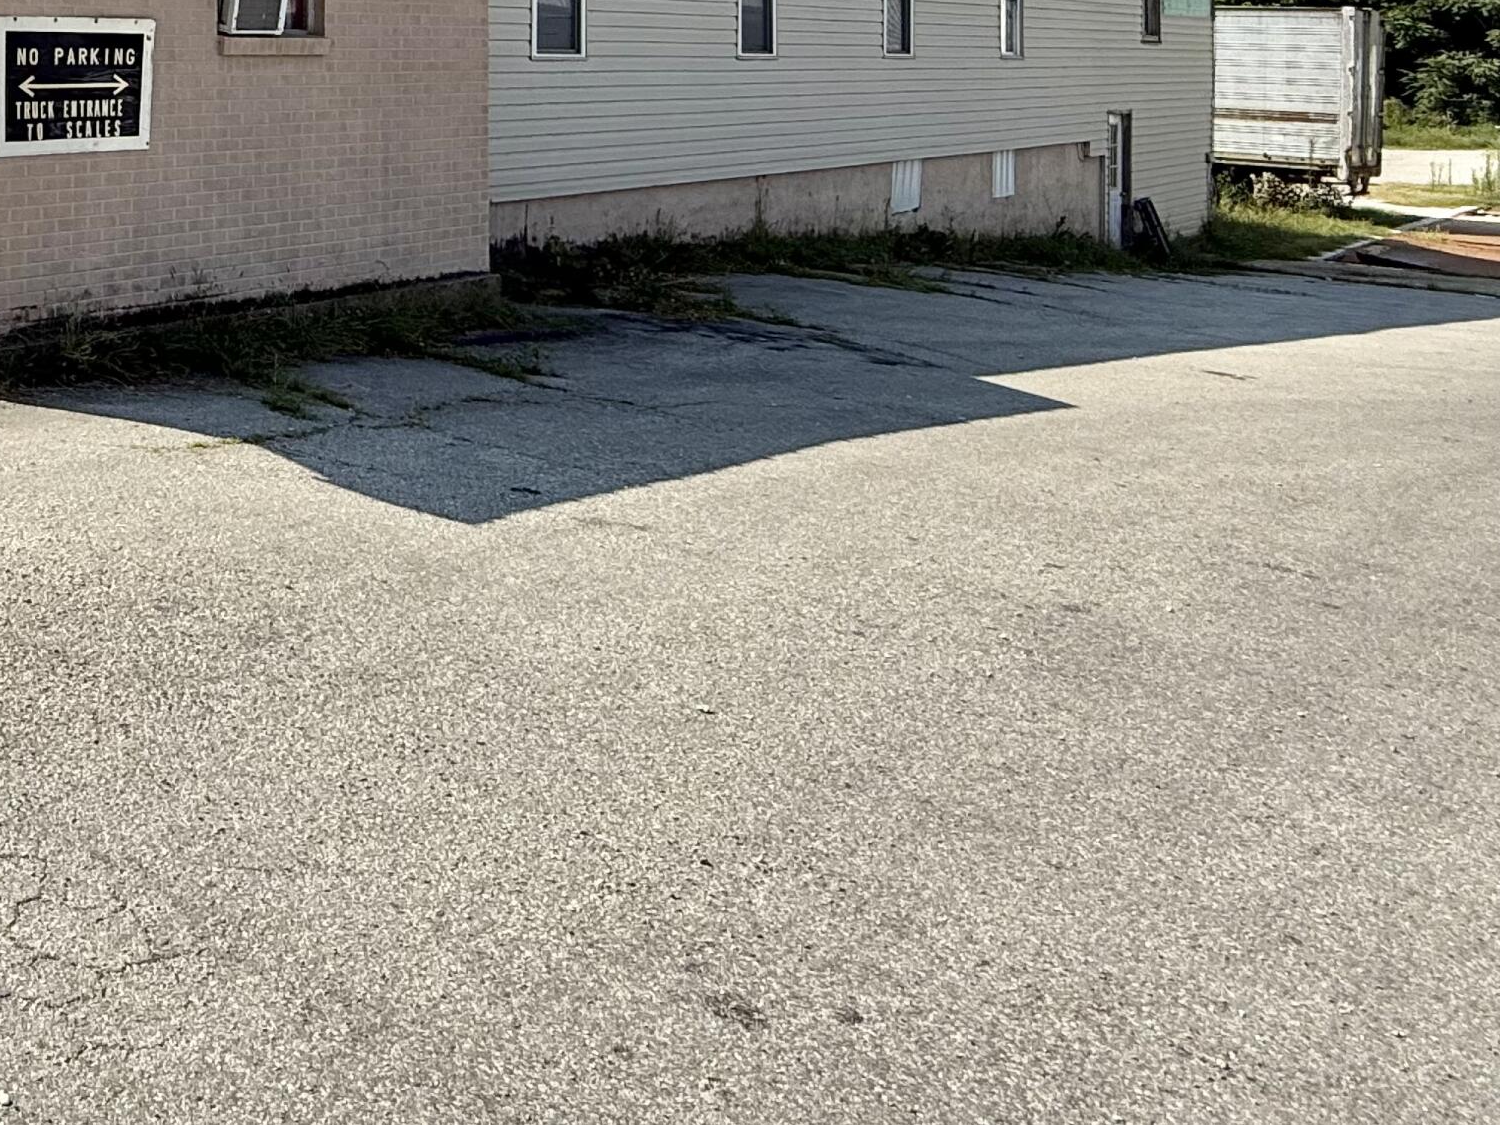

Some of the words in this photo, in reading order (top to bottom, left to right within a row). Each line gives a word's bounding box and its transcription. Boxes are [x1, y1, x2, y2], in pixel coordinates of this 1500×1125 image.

[16, 47, 39, 66] NO
[53, 47, 136, 66] PARKING
[15, 101, 55, 120] TRUCK
[63, 99, 124, 118] ENTRANCE
[26, 123, 44, 141] TO
[66, 120, 122, 139] SCALES
